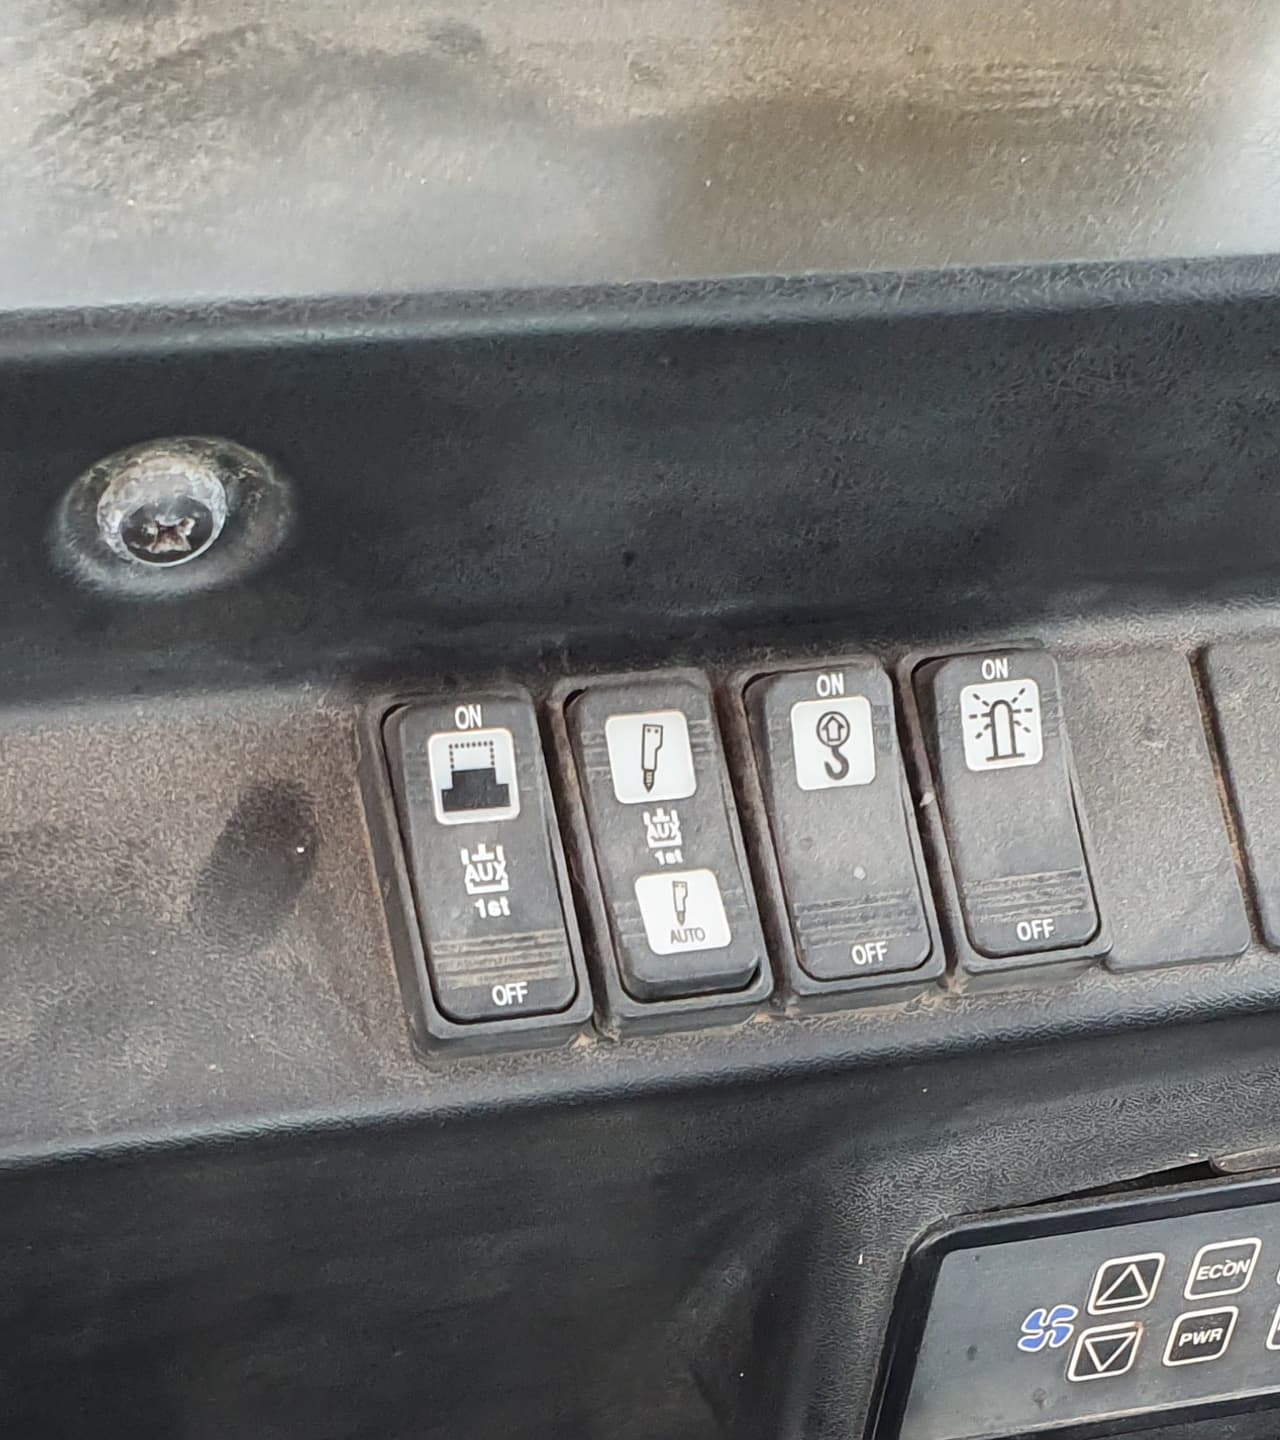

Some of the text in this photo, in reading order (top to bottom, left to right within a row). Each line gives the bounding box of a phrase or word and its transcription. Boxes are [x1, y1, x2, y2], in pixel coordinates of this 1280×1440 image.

[982, 659, 1009, 681] ON
[816, 673, 844, 697] ON
[454, 705, 482, 729] ON
[646, 819, 680, 841] AUX
[654, 848, 684, 865] 1st
[465, 861, 508, 882] AUX
[475, 896, 511, 918] 1st
[669, 926, 706, 945] AUTO
[1017, 918, 1055, 942] OFF
[851, 943, 889, 966] OFF
[491, 983, 529, 1007] OFF
[1196, 1256, 1250, 1282] ECON
[1178, 1324, 1224, 1347] PWR
